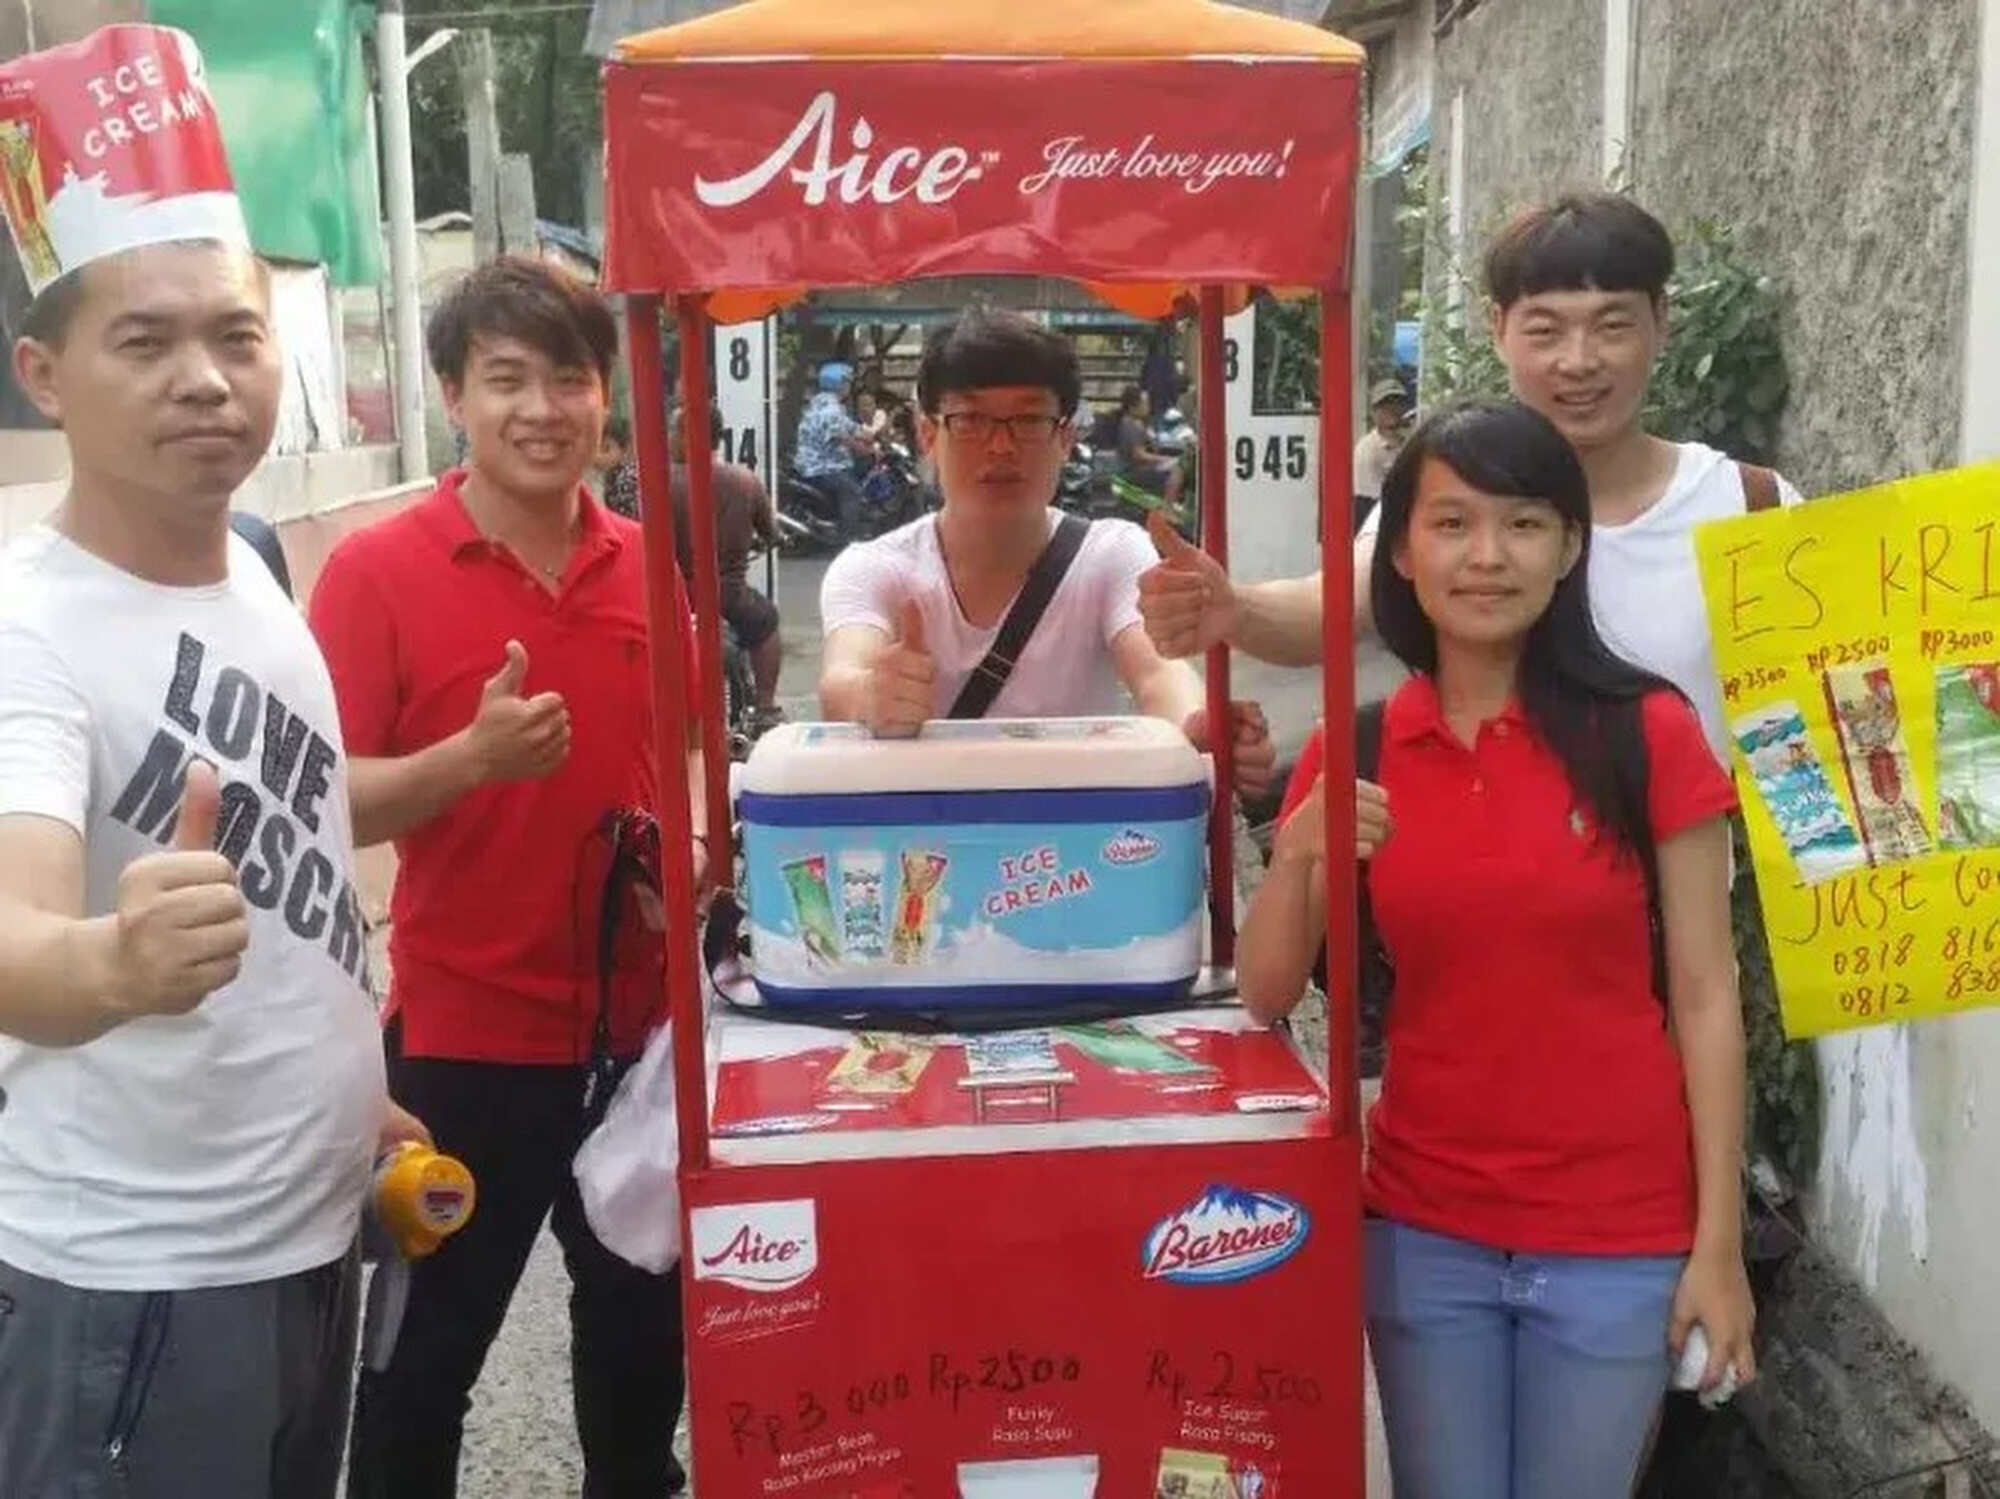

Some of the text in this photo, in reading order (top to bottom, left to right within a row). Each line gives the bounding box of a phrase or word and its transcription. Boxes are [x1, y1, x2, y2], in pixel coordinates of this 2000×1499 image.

[87, 55, 163, 108] ICE
[83, 90, 204, 158] CREAM
[694, 91, 982, 206] Aice
[1018, 135, 1120, 194] Just
[1121, 134, 1202, 179] love
[1184, 139, 1295, 193] you!
[729, 336, 750, 382] 8
[1724, 535, 1824, 642] ES
[164, 631, 337, 834] LOVE
[1001, 848, 1056, 880] ICE
[986, 868, 1093, 915] CREAM
[1834, 933, 1915, 975] 0818
[1840, 983, 1913, 1016] 0812
[702, 1223, 801, 1266] Aice
[1146, 1209, 1299, 1278] Baronet
